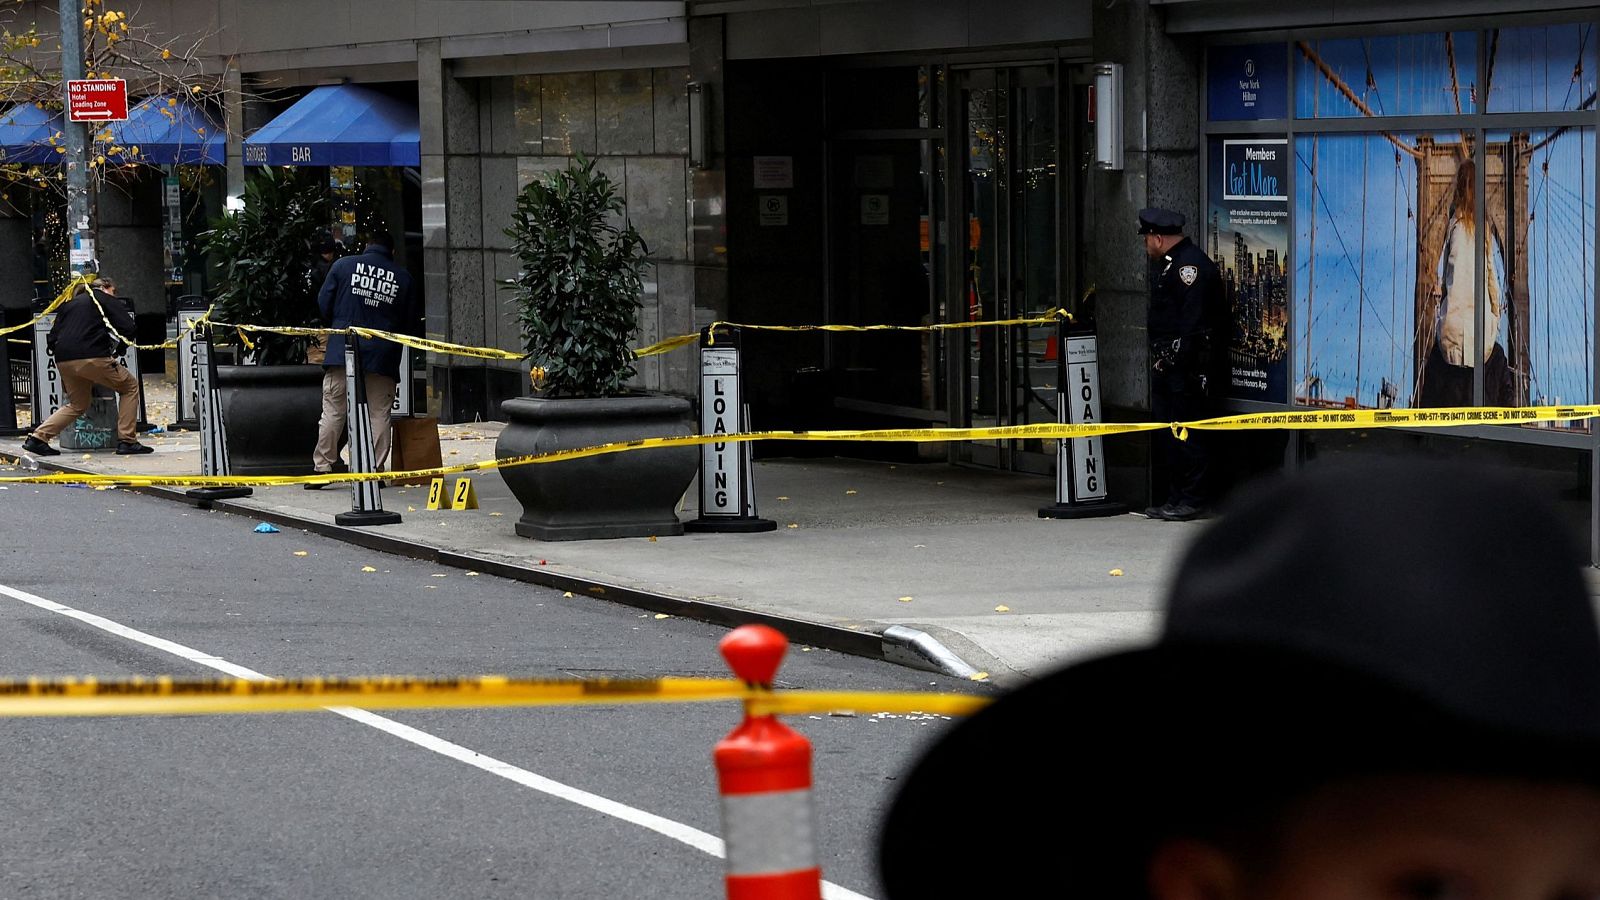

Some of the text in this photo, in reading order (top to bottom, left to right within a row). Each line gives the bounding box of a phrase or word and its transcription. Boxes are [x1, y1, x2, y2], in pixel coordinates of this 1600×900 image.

[72, 84, 116, 92] NO STANDING
[1240, 80, 1260, 89] New York
[1243, 92, 1256, 101] Hilton
[292, 147, 311, 162] BAR
[1246, 147, 1276, 160] Members
[1230, 161, 1278, 198] Get More
[356, 263, 396, 283] N.Y.P.D.
[351, 274, 399, 297] POLICE
[352, 287, 394, 304] CRIME SCENE
[365, 298, 380, 307] UNIT
[1288, 414, 1302, 423] CRIME
[1303, 415, 1317, 423] SCENE
[1323, 414, 1329, 422] DO
[1330, 414, 1339, 422] NOT
[1340, 414, 1355, 422] CROSS
[1467, 412, 1482, 420] CRIME
[1483, 412, 1498, 420] SCENE
[1503, 411, 1510, 419] DO
[1081, 367, 1097, 492] LOAING
[431, 482, 438, 503] 3
[457, 482, 466, 502] 2
